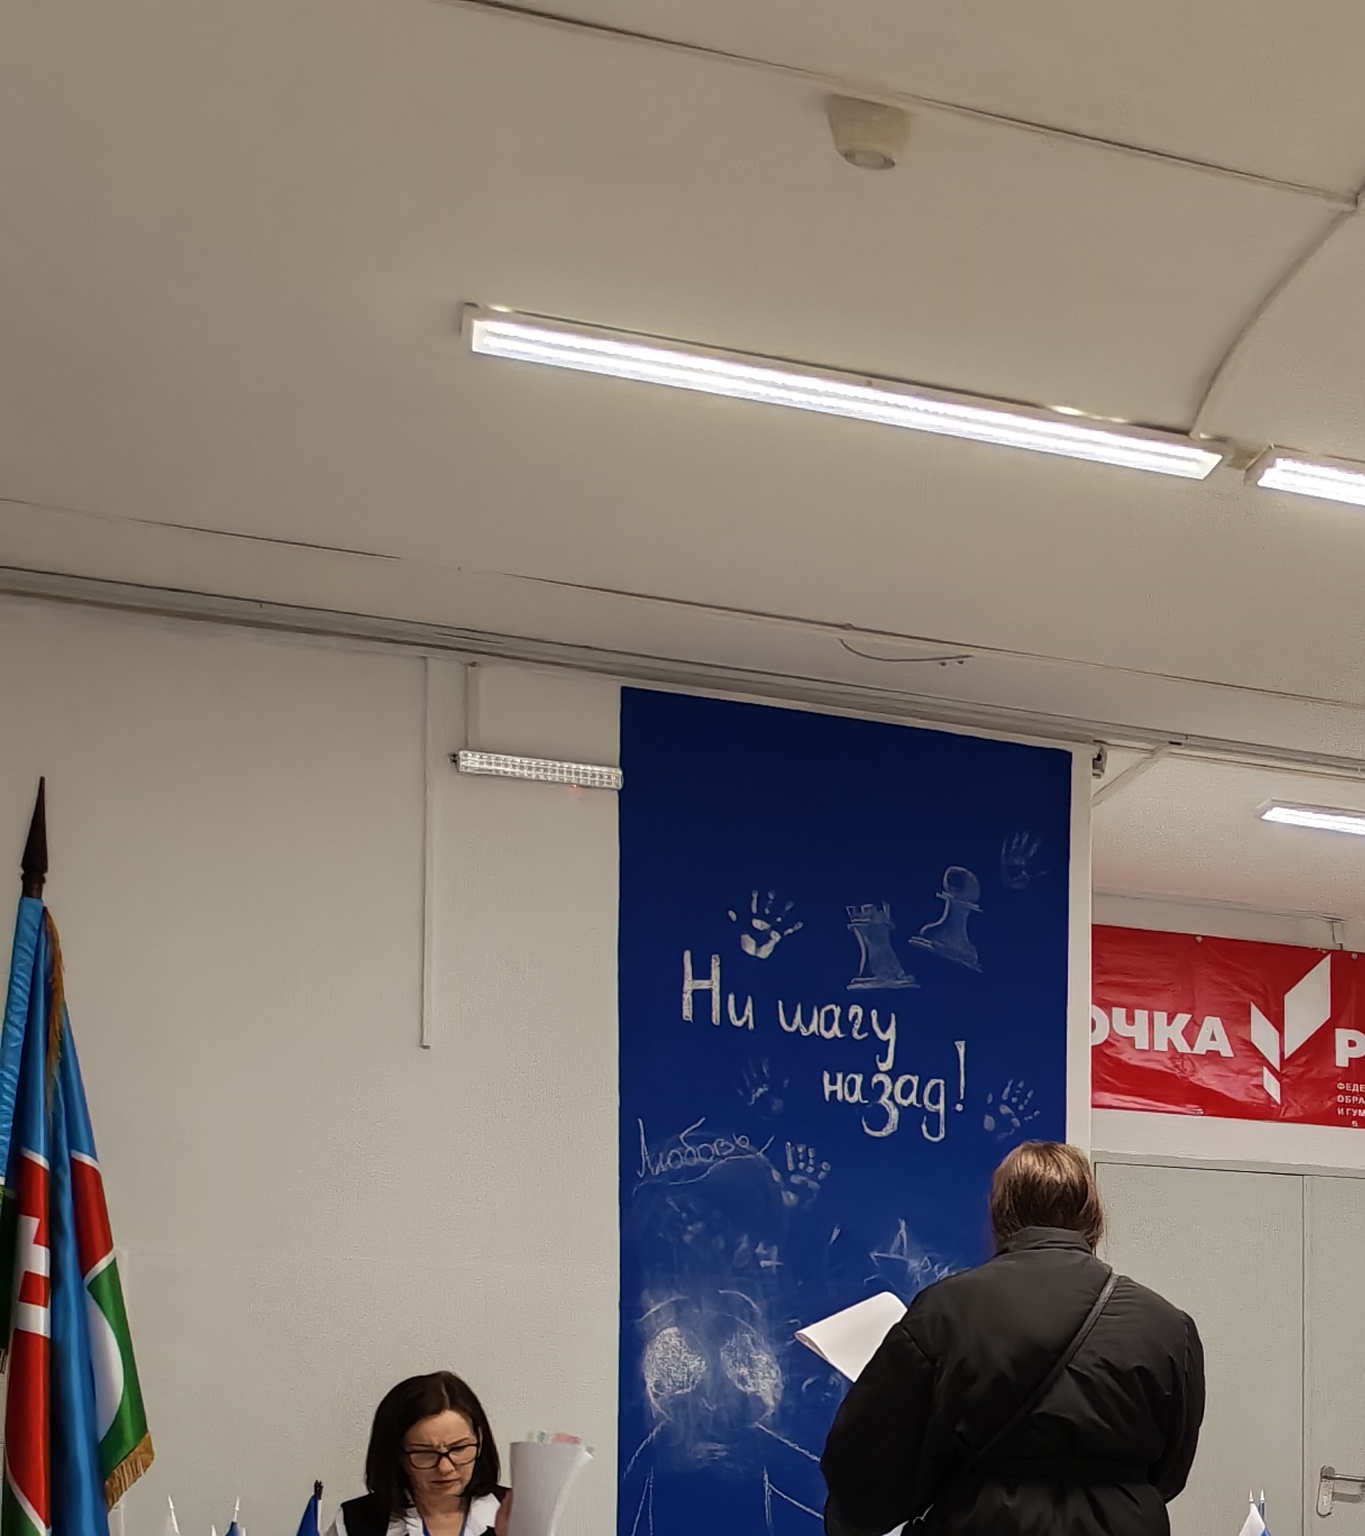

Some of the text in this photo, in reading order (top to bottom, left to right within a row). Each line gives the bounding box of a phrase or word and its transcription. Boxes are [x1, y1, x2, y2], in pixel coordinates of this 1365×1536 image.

[682, 949, 897, 1071] Ни шагу
[1092, 1004, 1234, 1058] ЧКА
[823, 1040, 967, 1142] назад!
[1337, 1108, 1344, 1116] И
